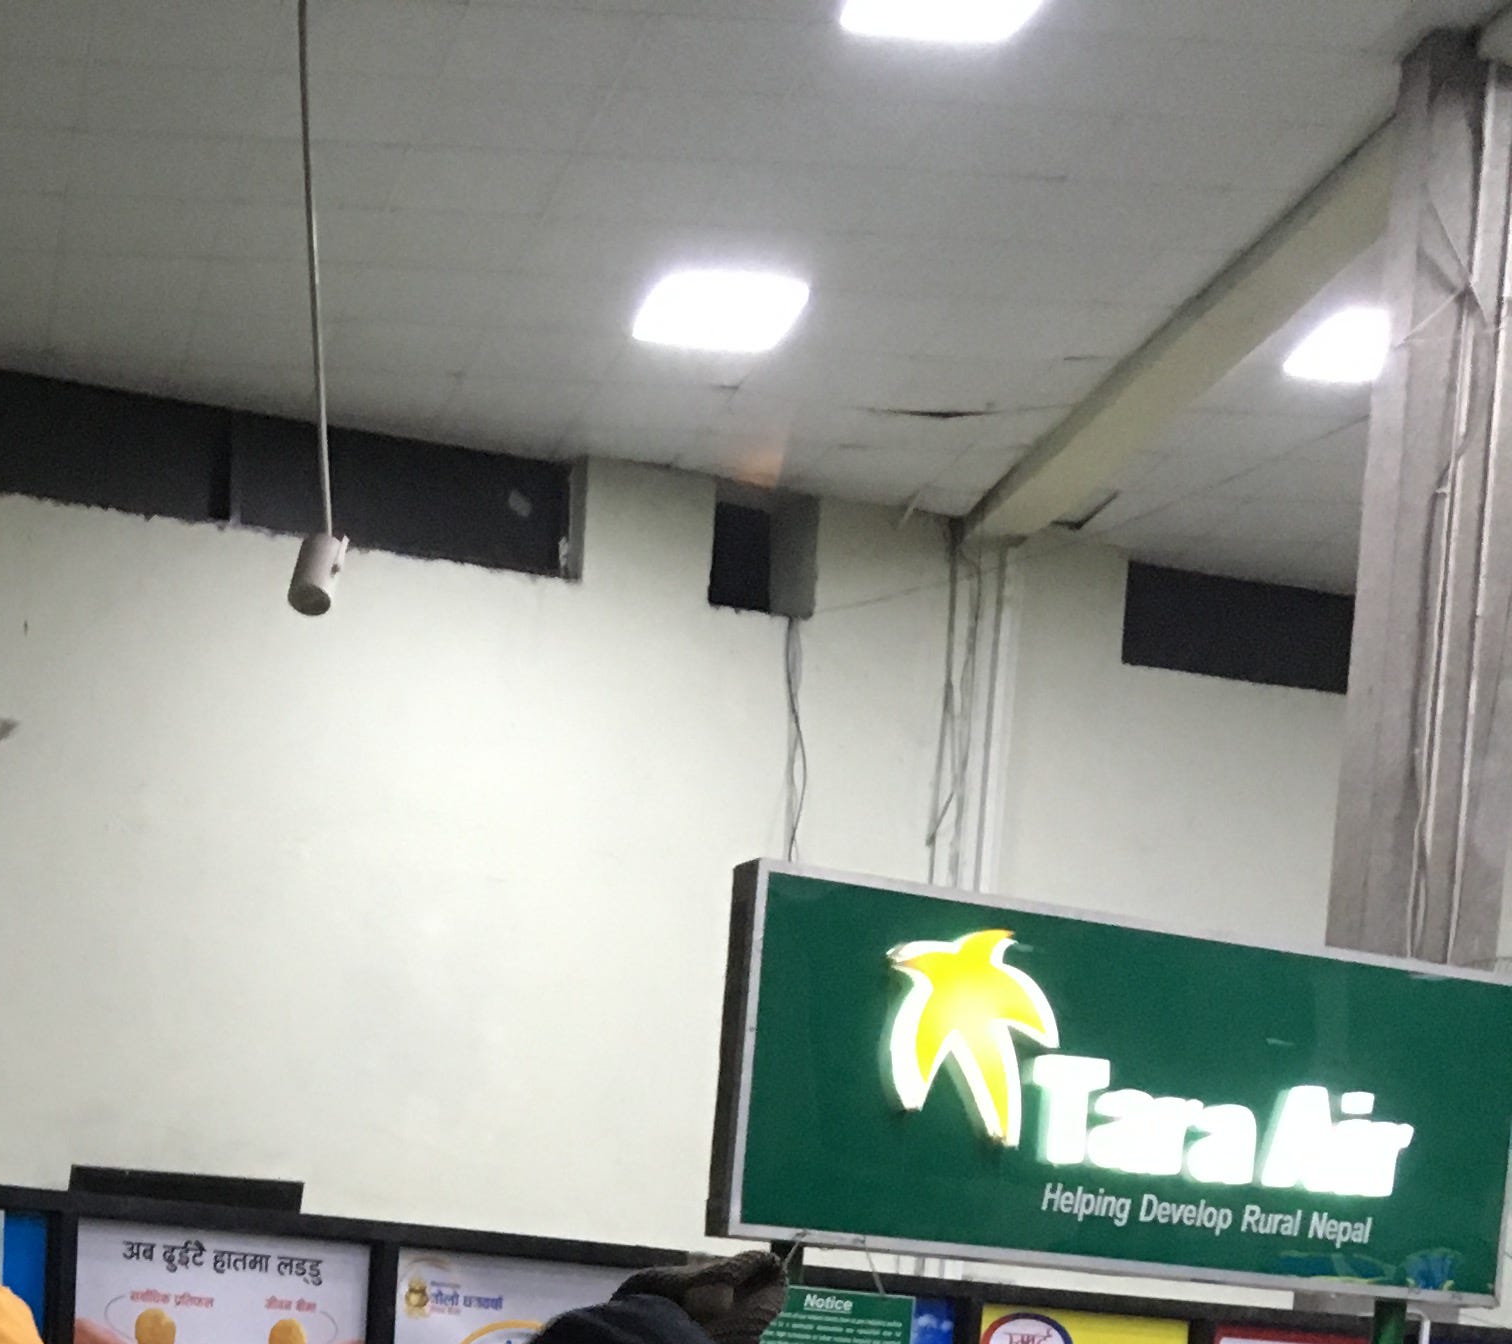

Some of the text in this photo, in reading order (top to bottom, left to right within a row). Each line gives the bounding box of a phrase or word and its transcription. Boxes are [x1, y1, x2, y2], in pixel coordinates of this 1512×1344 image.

[1033, 1054, 1415, 1197] Tara Air
[1041, 1182, 1373, 1249] Helping Develop Rural Nepal
[123, 1240, 156, 1261] अब
[213, 1248, 271, 1273] हातमा
[804, 1293, 853, 1312] Notice
